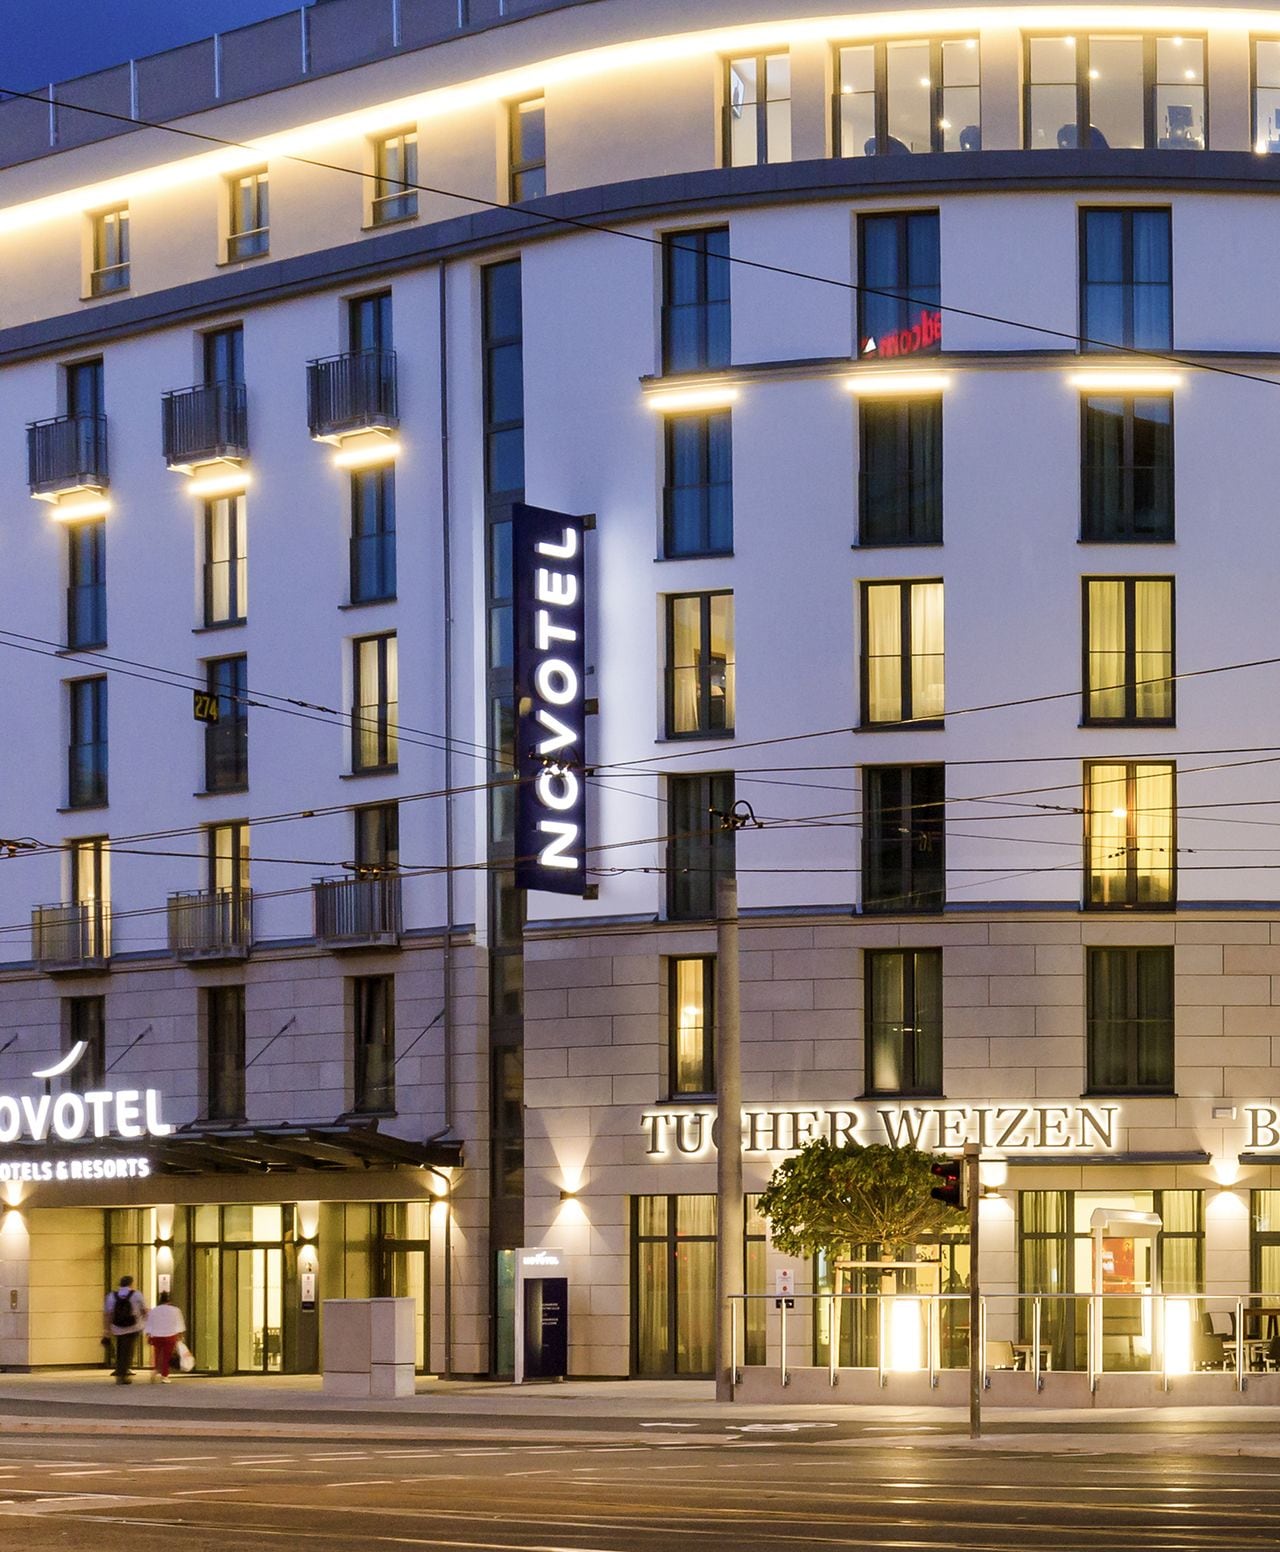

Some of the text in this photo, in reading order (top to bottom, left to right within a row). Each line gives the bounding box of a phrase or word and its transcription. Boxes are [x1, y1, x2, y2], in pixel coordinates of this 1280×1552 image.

[195, 694, 217, 720] 274
[536, 527, 579, 870] NOVOTEL
[0, 1089, 175, 1143] OVOTEL
[877, 1107, 1118, 1149] WEIZEN
[0, 1157, 150, 1182] OTELS & RESORTS
